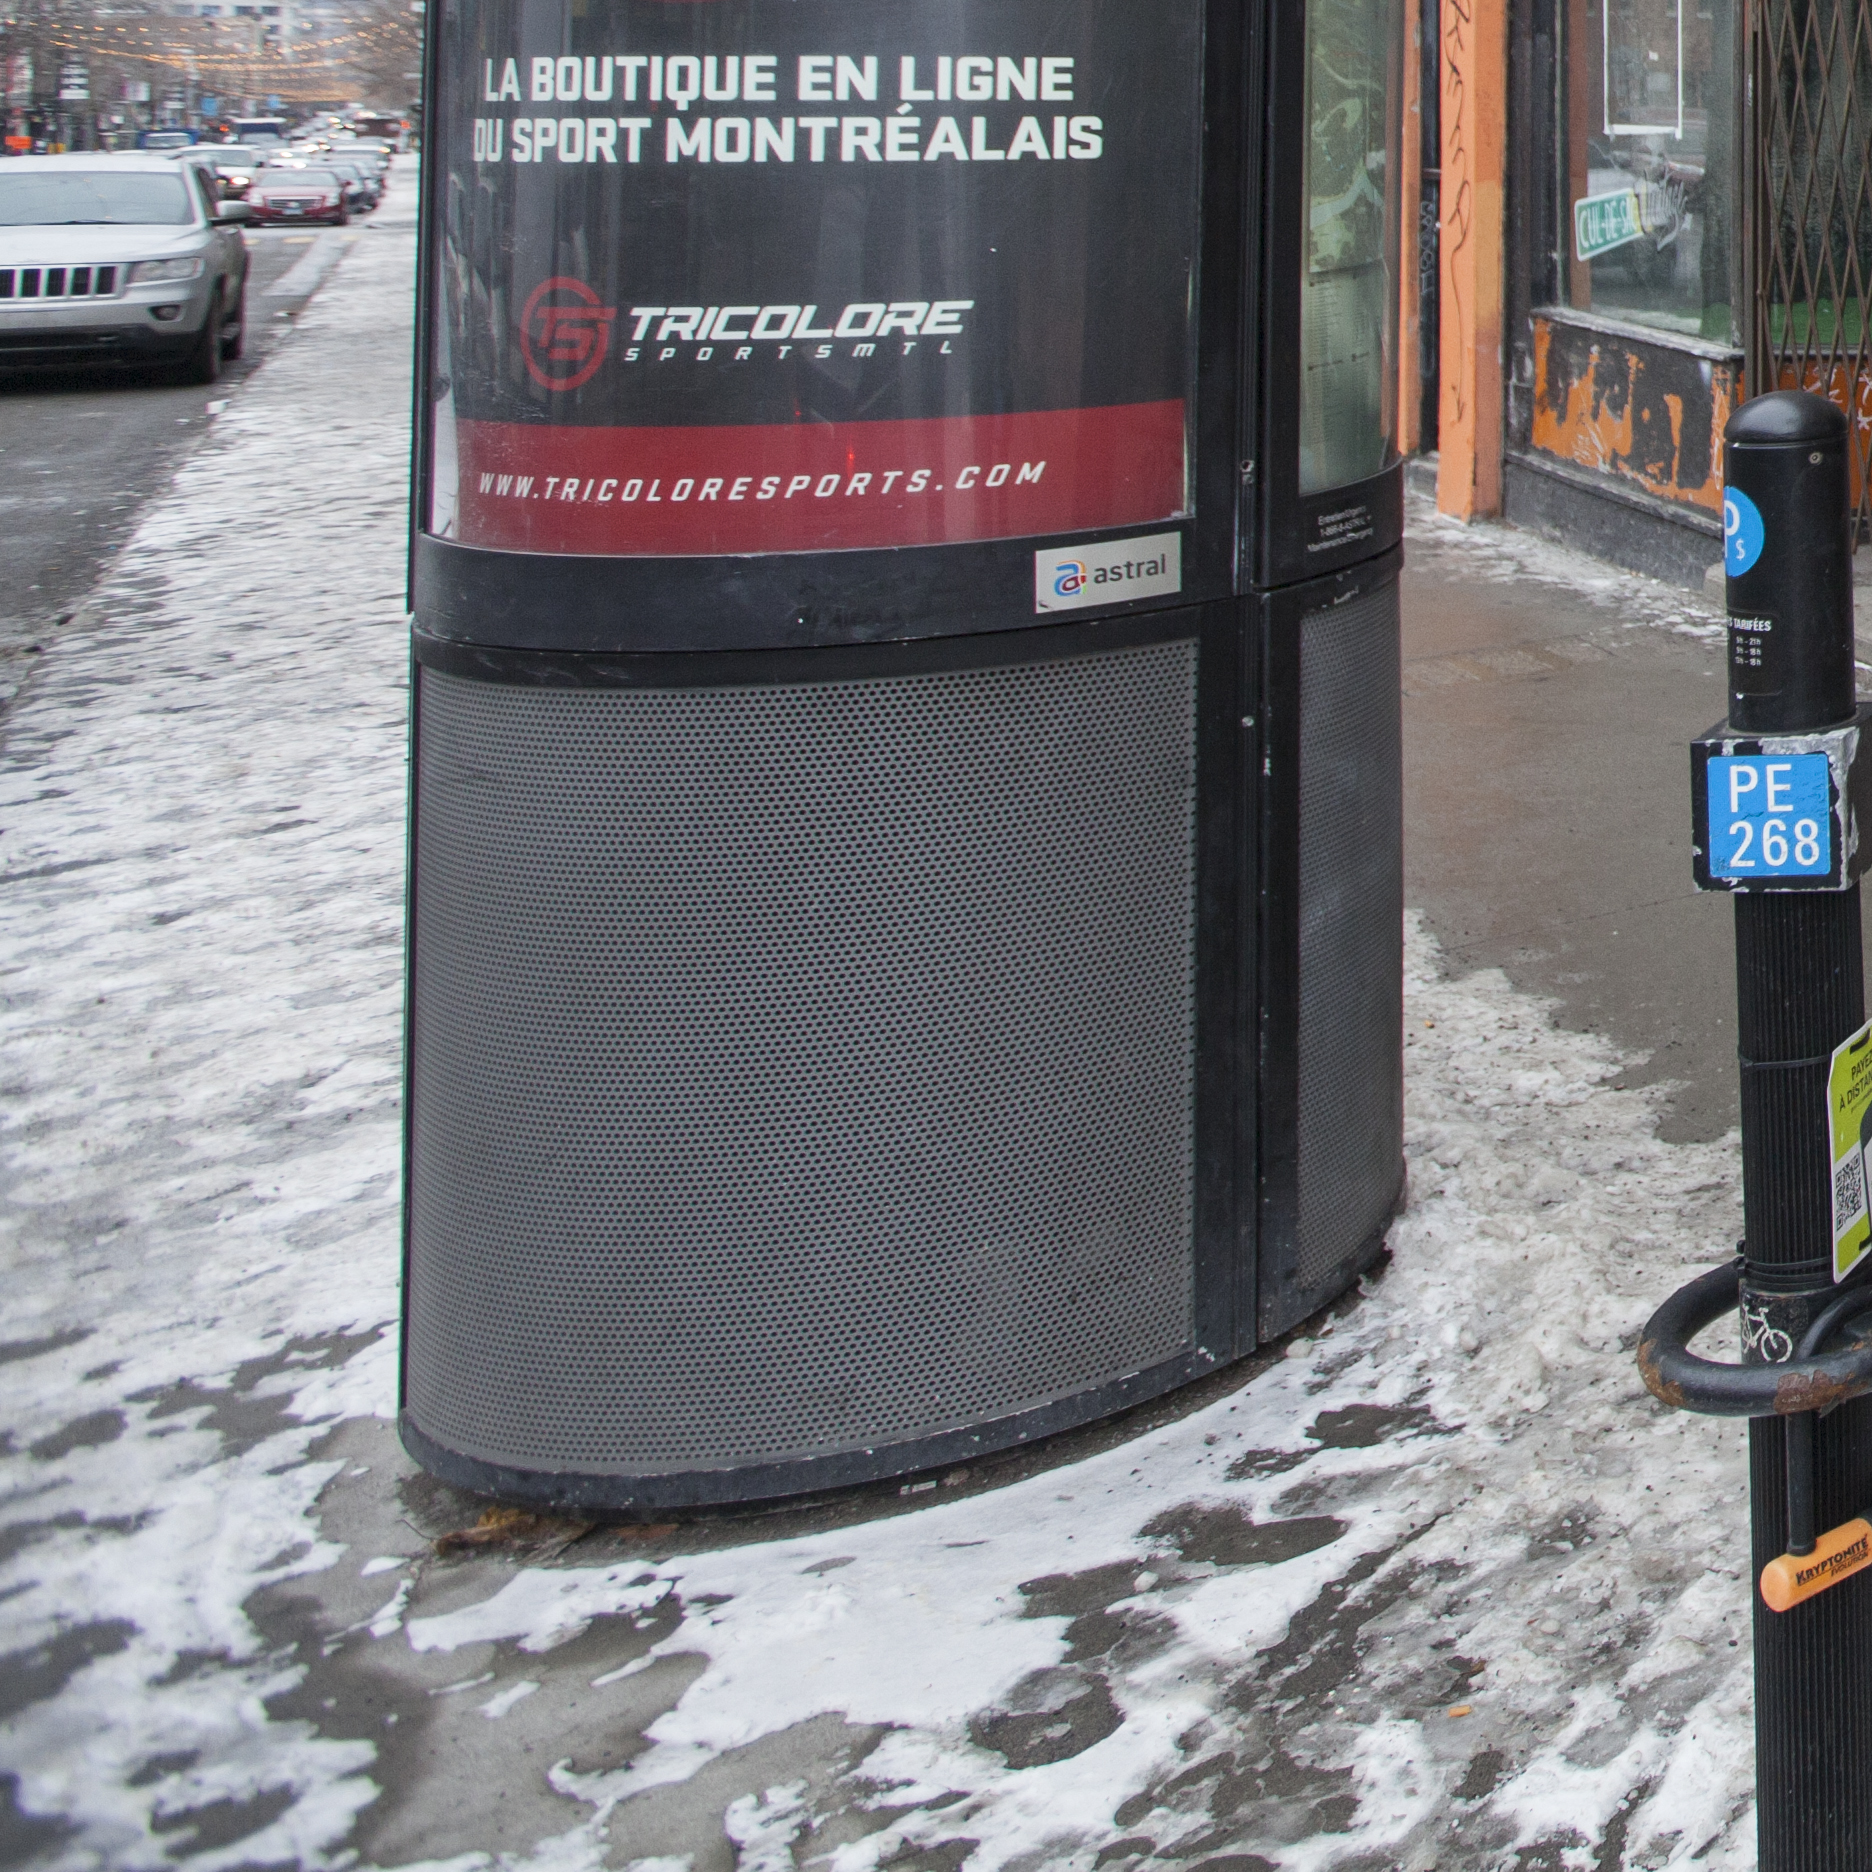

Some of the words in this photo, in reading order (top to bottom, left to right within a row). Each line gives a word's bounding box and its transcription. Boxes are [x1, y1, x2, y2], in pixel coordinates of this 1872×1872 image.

[483, 57, 521, 102] LA
[530, 56, 777, 110] BOUTIQUE
[797, 56, 878, 101] EN
[899, 56, 1075, 101] LIGNE
[474, 117, 503, 162] DU
[512, 116, 652, 162] SPORT
[665, 102, 1104, 163] MONTRÉALAIS
[629, 300, 975, 341] TRICOLORE
[479, 461, 1047, 503] WWW.TRICOLORESPORTS.COM
[1093, 553, 1167, 585] astral
[1729, 763, 1793, 813] PE
[1728, 819, 1819, 868] 268
[1850, 1048, 1872, 1081] PAYEZ
[1838, 1093, 1846, 1113] À
[1795, 1536, 1869, 1586] KRYPTONITE
